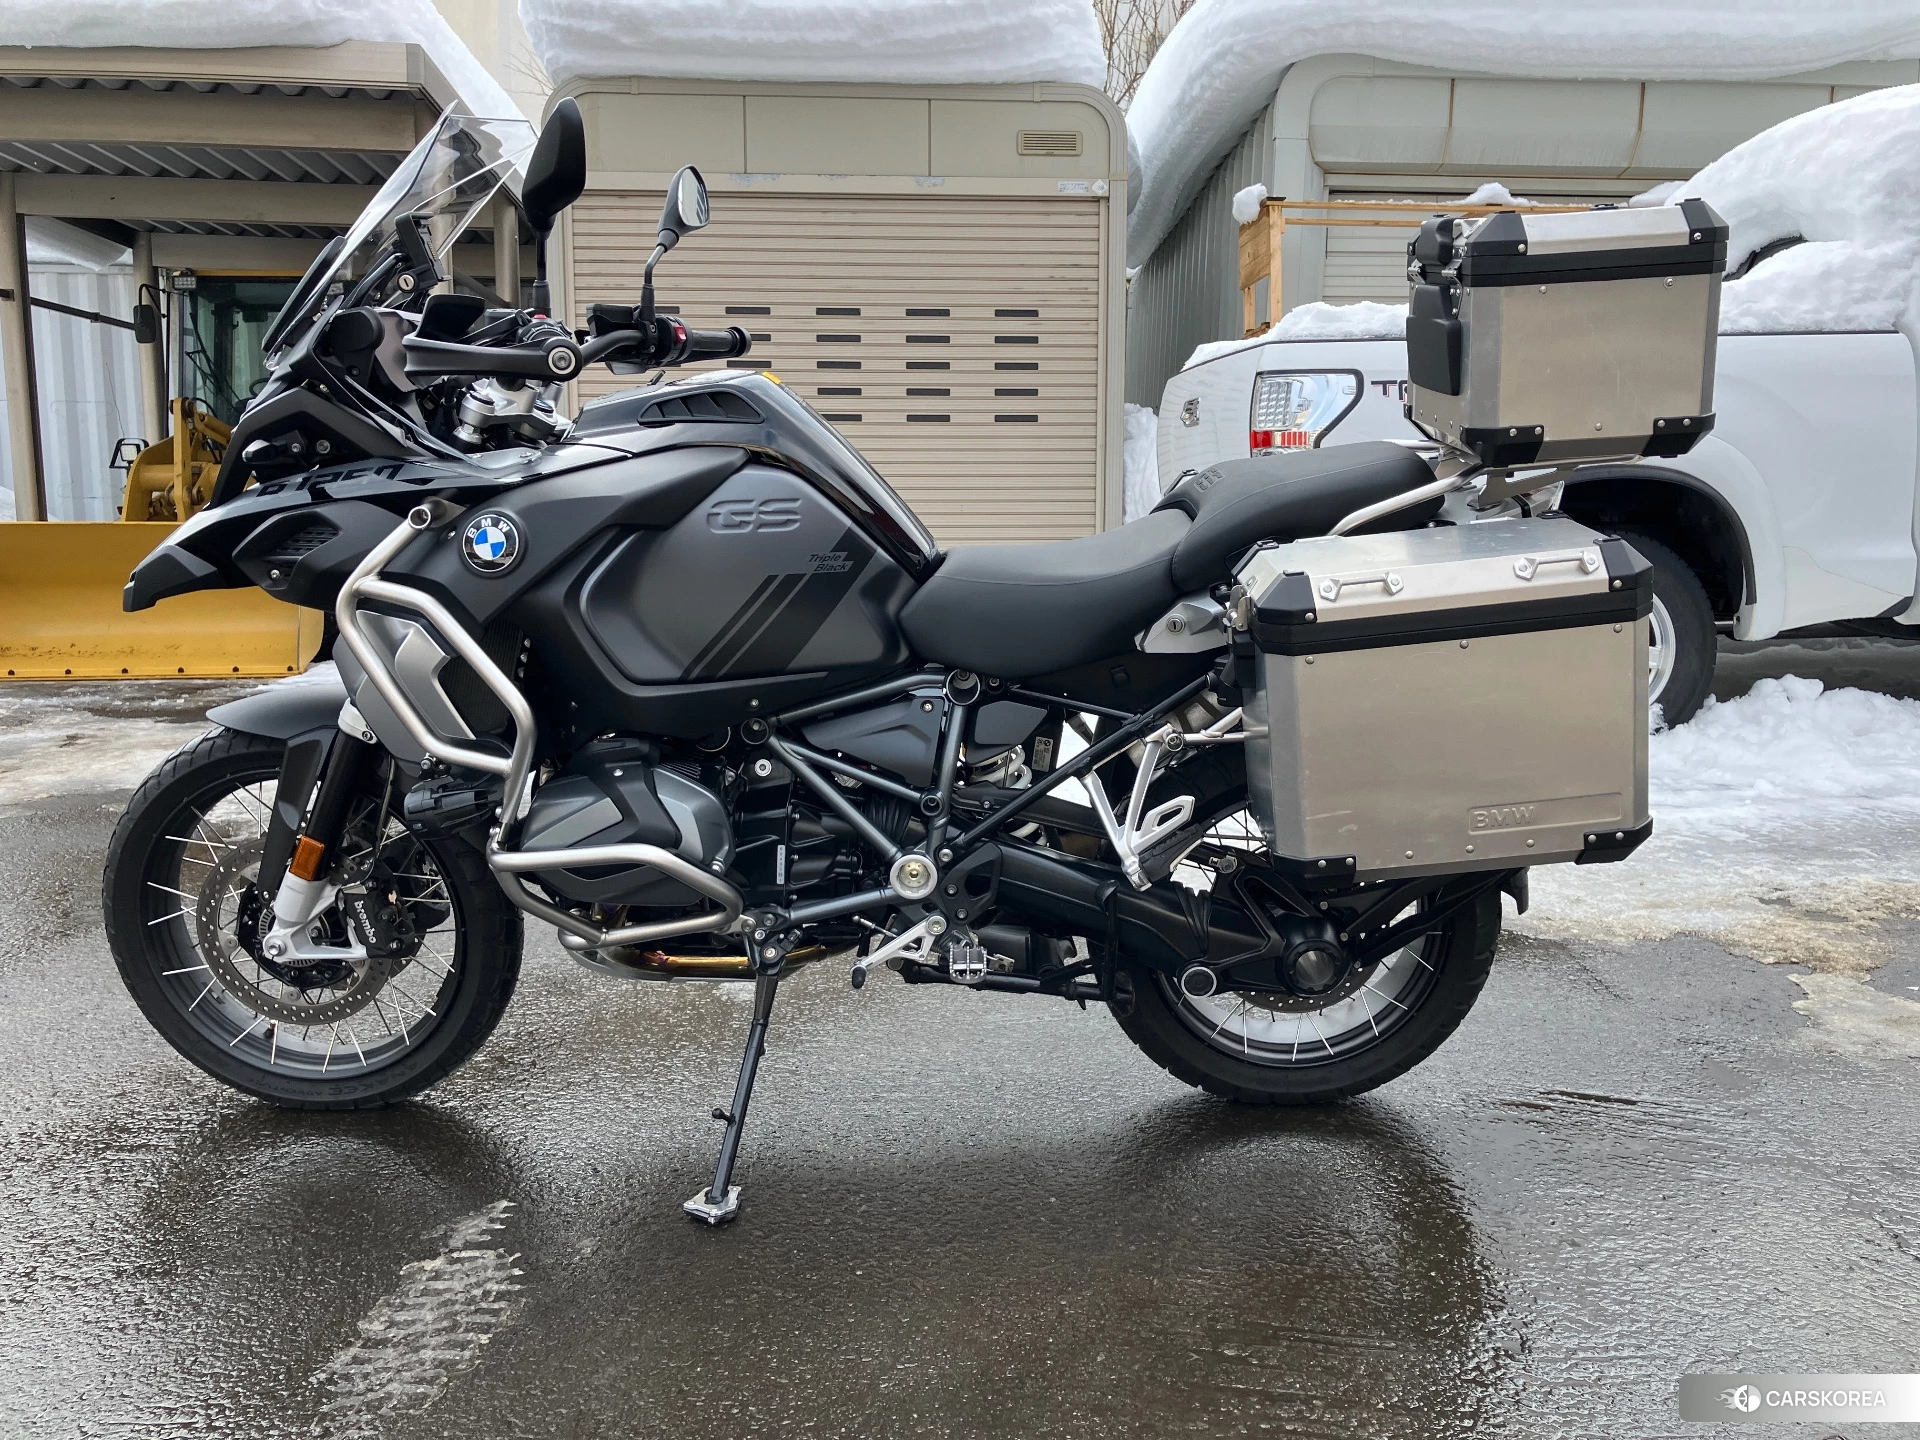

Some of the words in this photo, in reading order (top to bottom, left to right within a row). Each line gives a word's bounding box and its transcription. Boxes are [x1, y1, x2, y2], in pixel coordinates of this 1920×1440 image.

[706, 498, 802, 534] GS
[467, 517, 511, 539] BMW
[808, 553, 842, 564] Triple
[813, 562, 849, 572] Black
[1473, 806, 1534, 829] BMW
[354, 900, 377, 944] brembo
